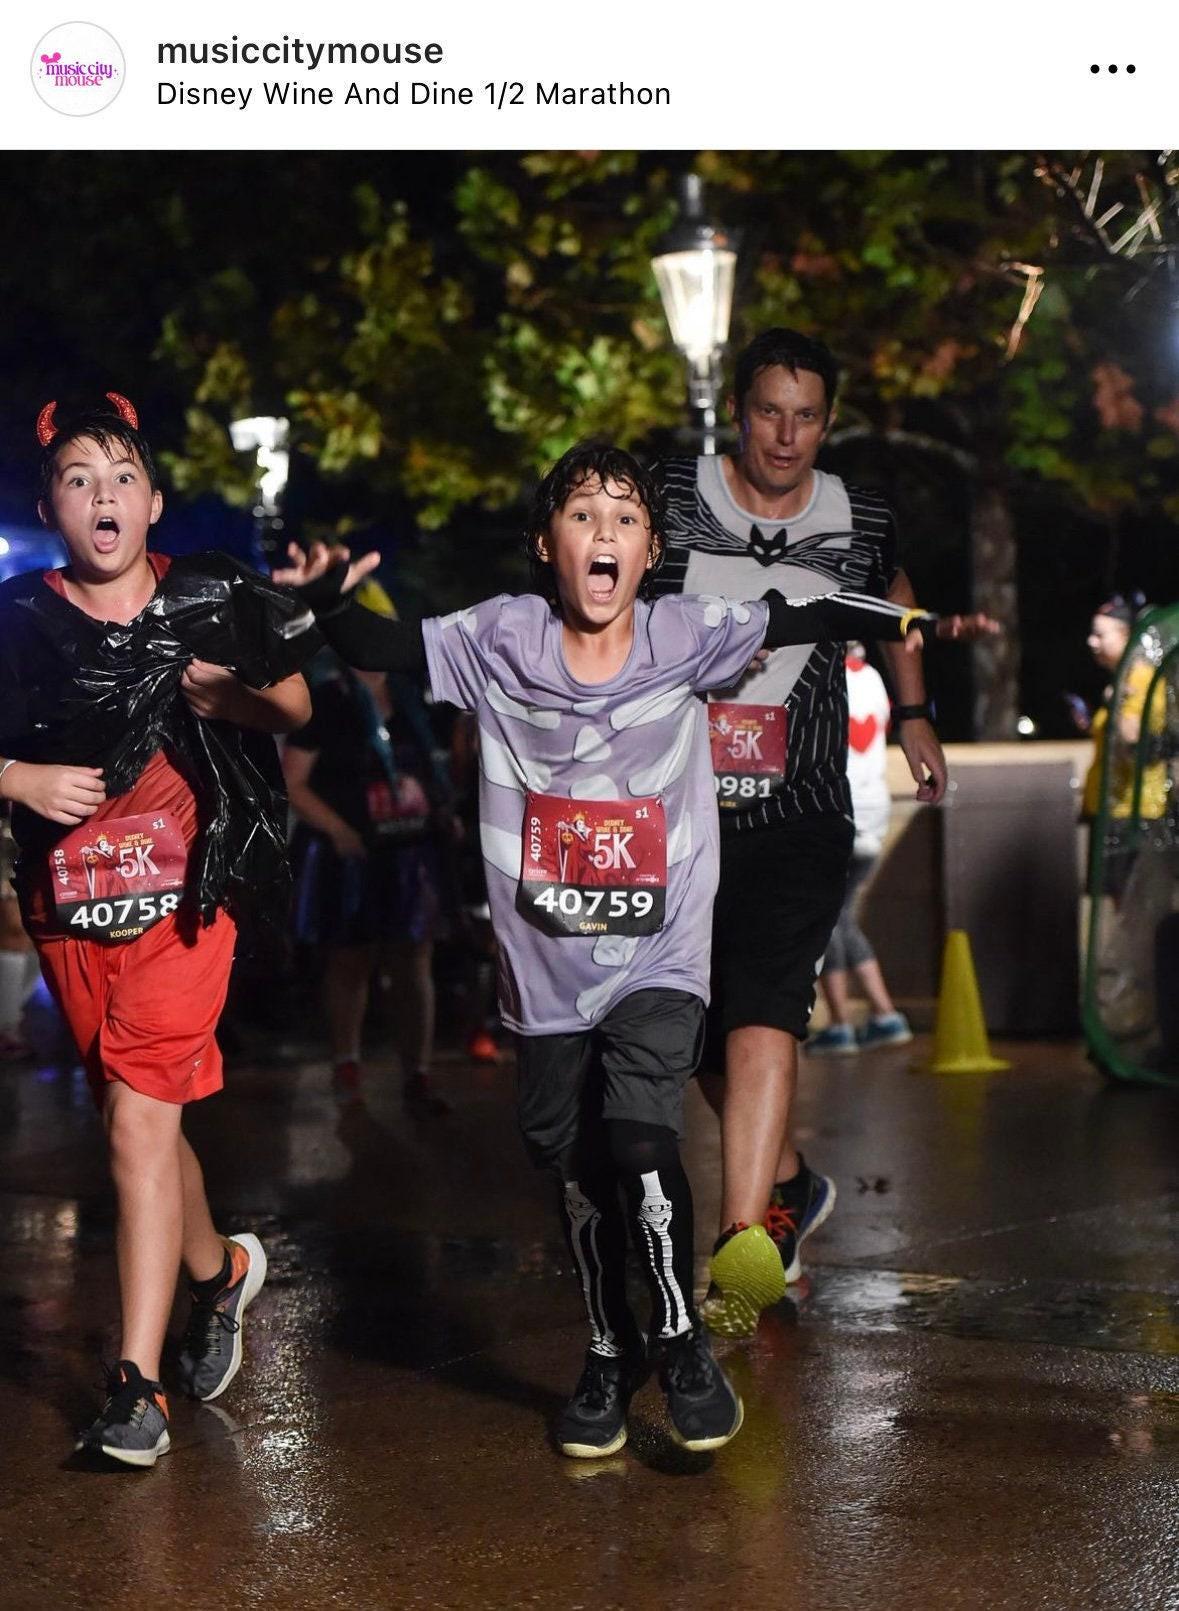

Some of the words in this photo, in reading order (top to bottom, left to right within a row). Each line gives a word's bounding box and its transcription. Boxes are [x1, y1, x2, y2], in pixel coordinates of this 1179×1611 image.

[730, 730, 763, 760] 5K
[152, 818, 166, 830] s1
[636, 807, 650, 819] s1
[530, 817, 542, 862] 40759
[592, 833, 636, 870] 5K
[54, 849, 70, 885] 40758
[119, 844, 161, 878] 5K
[70, 893, 179, 929] 40758
[534, 887, 654, 918] 40759
[110, 927, 144, 939] KOOPER
[579, 921, 608, 931] GAVIN
